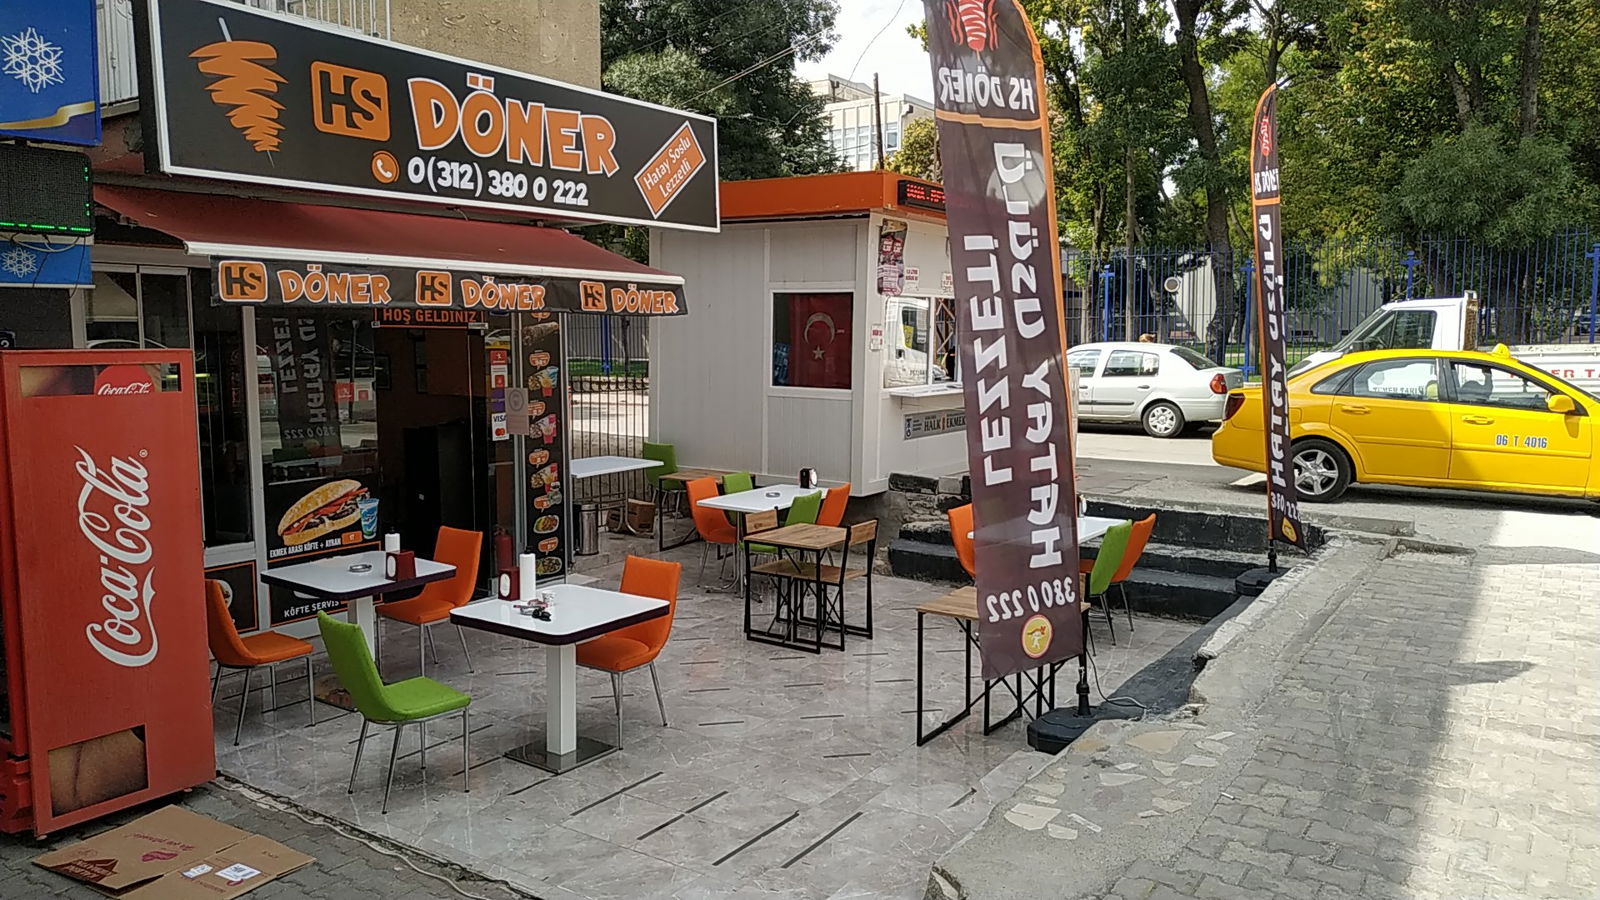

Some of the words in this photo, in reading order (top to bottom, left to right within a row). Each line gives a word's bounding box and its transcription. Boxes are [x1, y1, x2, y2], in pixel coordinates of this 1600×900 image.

[318, 69, 384, 133] HS
[407, 72, 620, 178] DÖNER
[408, 156, 482, 197] 0(312)
[488, 169, 528, 199] 380
[533, 175, 548, 200] 0
[553, 179, 589, 206] 222
[643, 159, 671, 190] Hatay
[668, 137, 692, 163] Soslu
[659, 158, 692, 197] Lezzetli
[223, 265, 264, 298] HS
[277, 264, 391, 304] DÖNER
[418, 273, 450, 303] HS
[461, 275, 546, 310] DÖNER
[582, 283, 605, 309] HS
[610, 284, 679, 314] DÖNER
[383, 308, 411, 324] HOŞ
[924, 417, 941, 432] HALK
[1270, 353, 1287, 488] HATAY
[1496, 434, 1508, 446] 06
[1513, 435, 1519, 447] T
[1524, 436, 1547, 449] 4016
[73, 444, 159, 668] Coca-Cola
[269, 547, 288, 558] EKMEK
[303, 541, 319, 552] KÖFTE
[284, 604, 310, 618] KÖFTE
